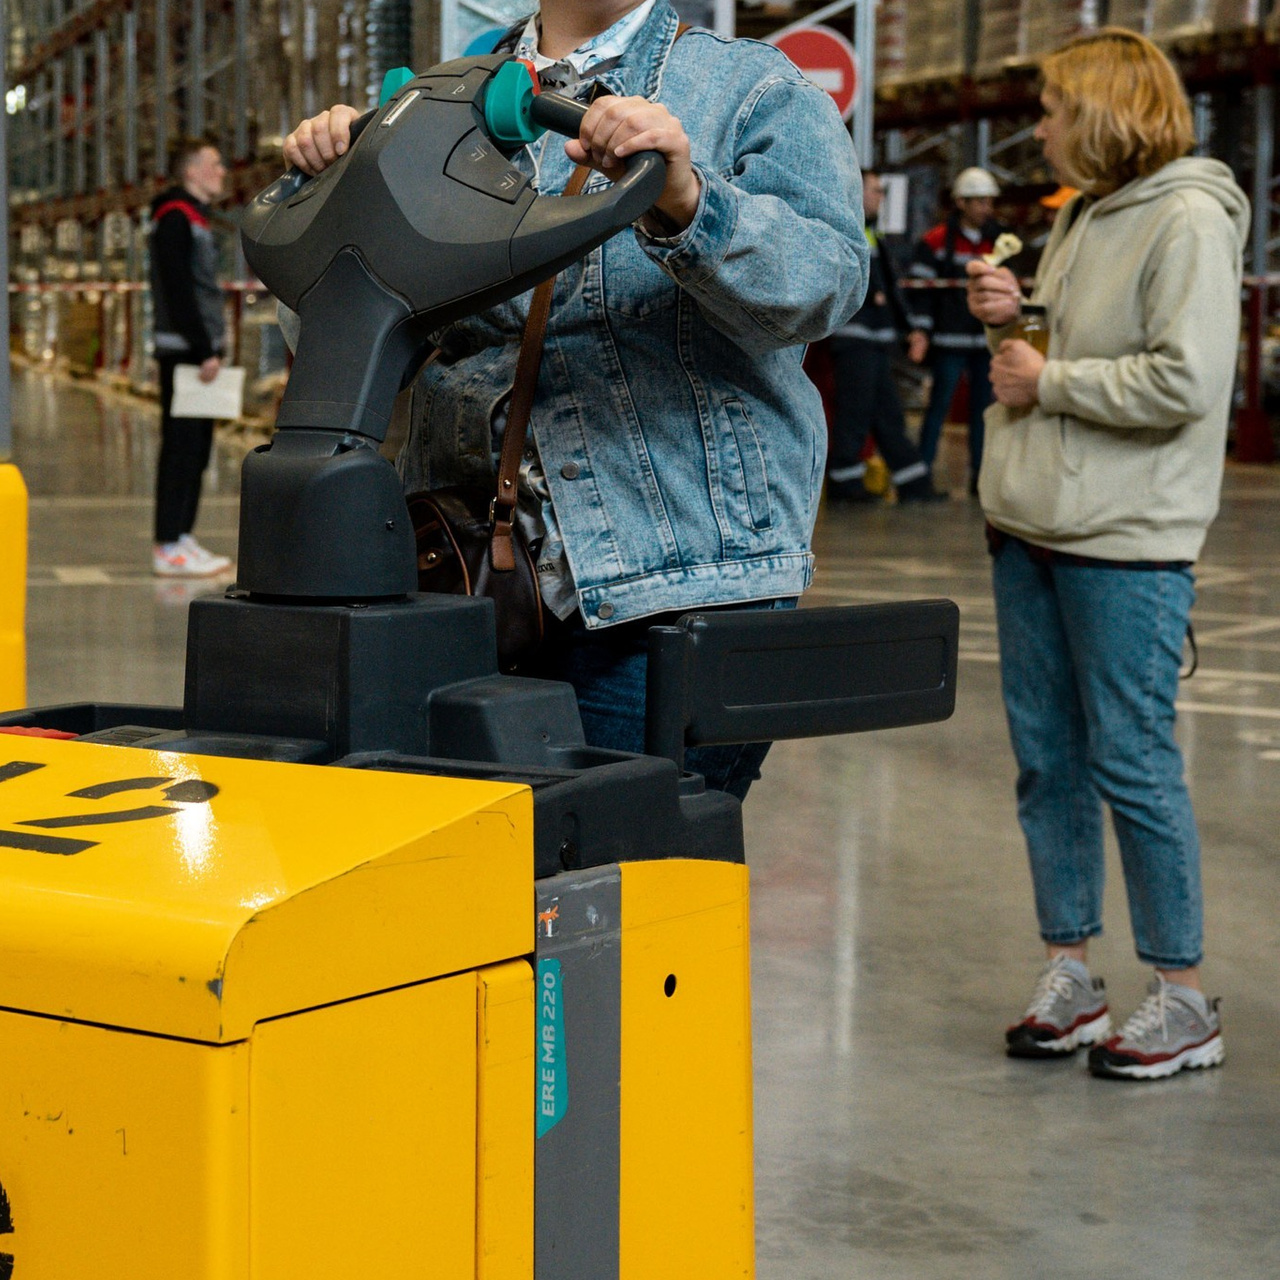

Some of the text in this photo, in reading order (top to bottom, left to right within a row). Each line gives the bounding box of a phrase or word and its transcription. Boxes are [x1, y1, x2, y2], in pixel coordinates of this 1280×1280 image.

[542, 972, 556, 1117] ERE MB 220
